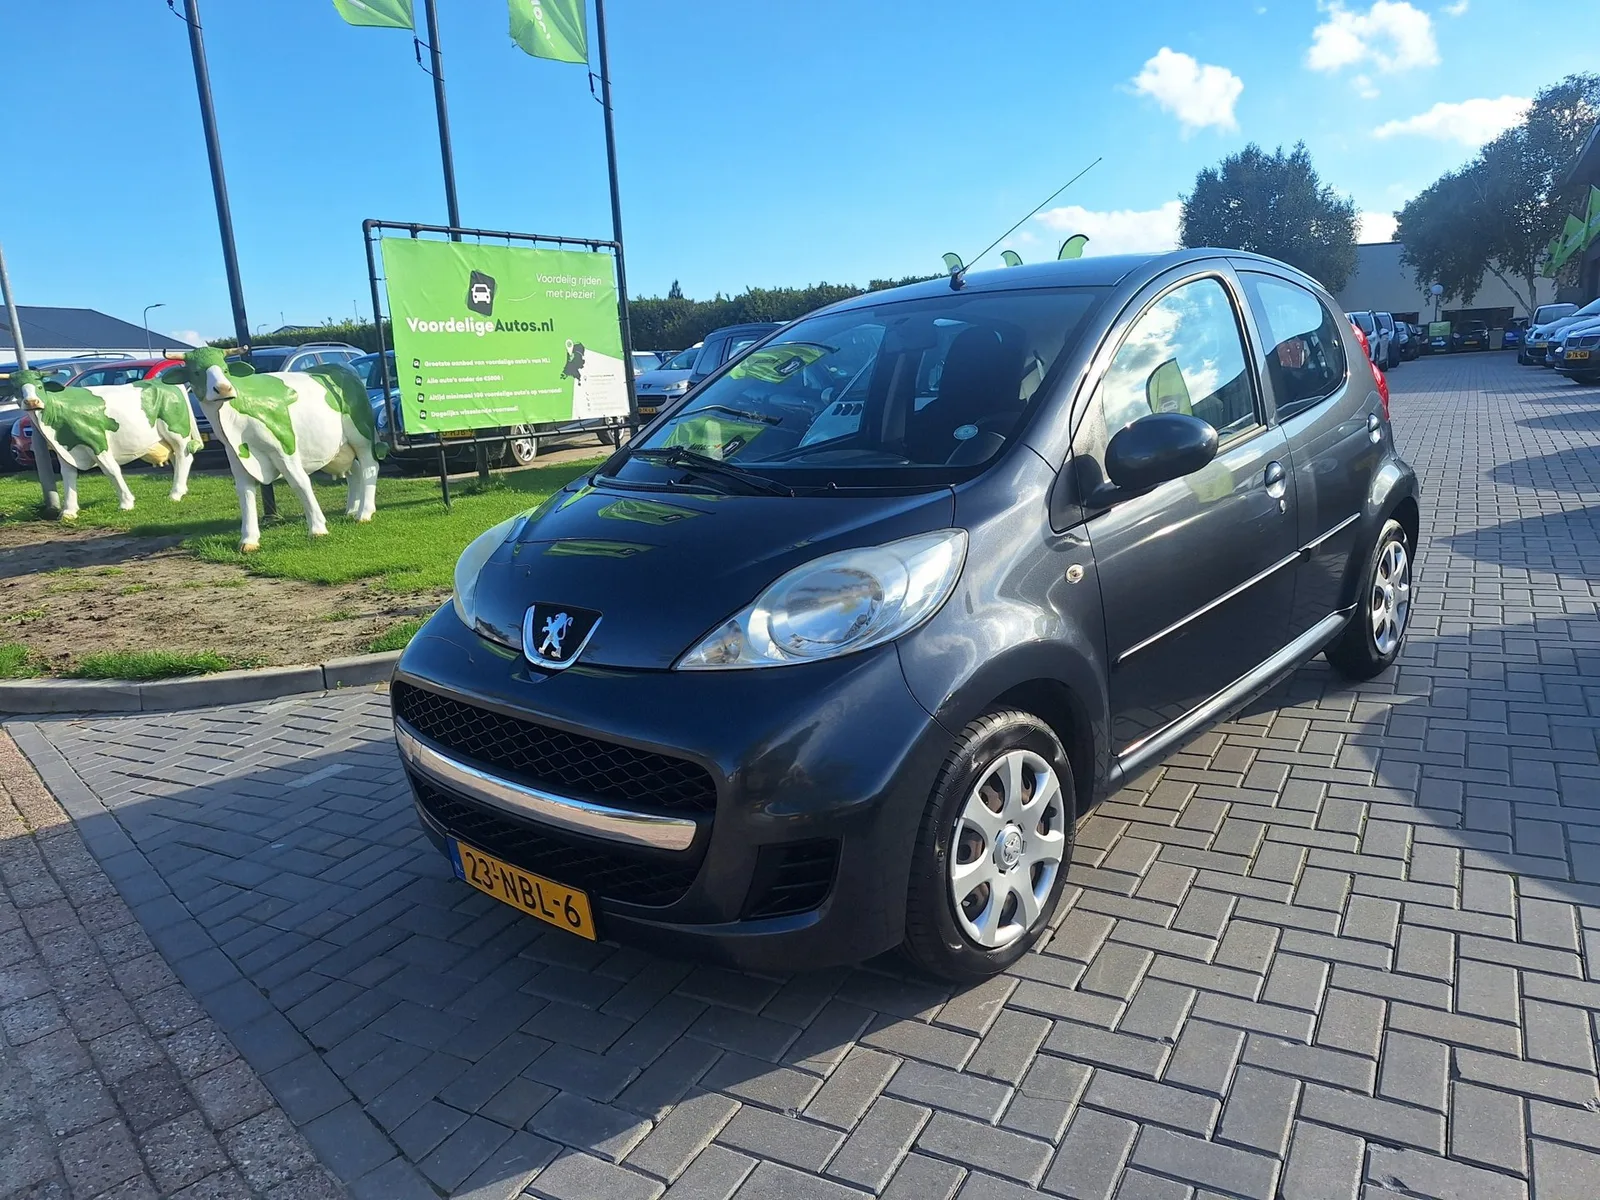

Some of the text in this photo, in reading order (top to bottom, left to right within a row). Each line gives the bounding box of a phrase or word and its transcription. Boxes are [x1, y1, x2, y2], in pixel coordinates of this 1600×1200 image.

[536, 273, 602, 287] Voordelig rijden
[546, 288, 596, 300] met plezier!
[406, 316, 554, 337] VoordeligeAutos.nl
[465, 851, 581, 928] 23-NBL-6
